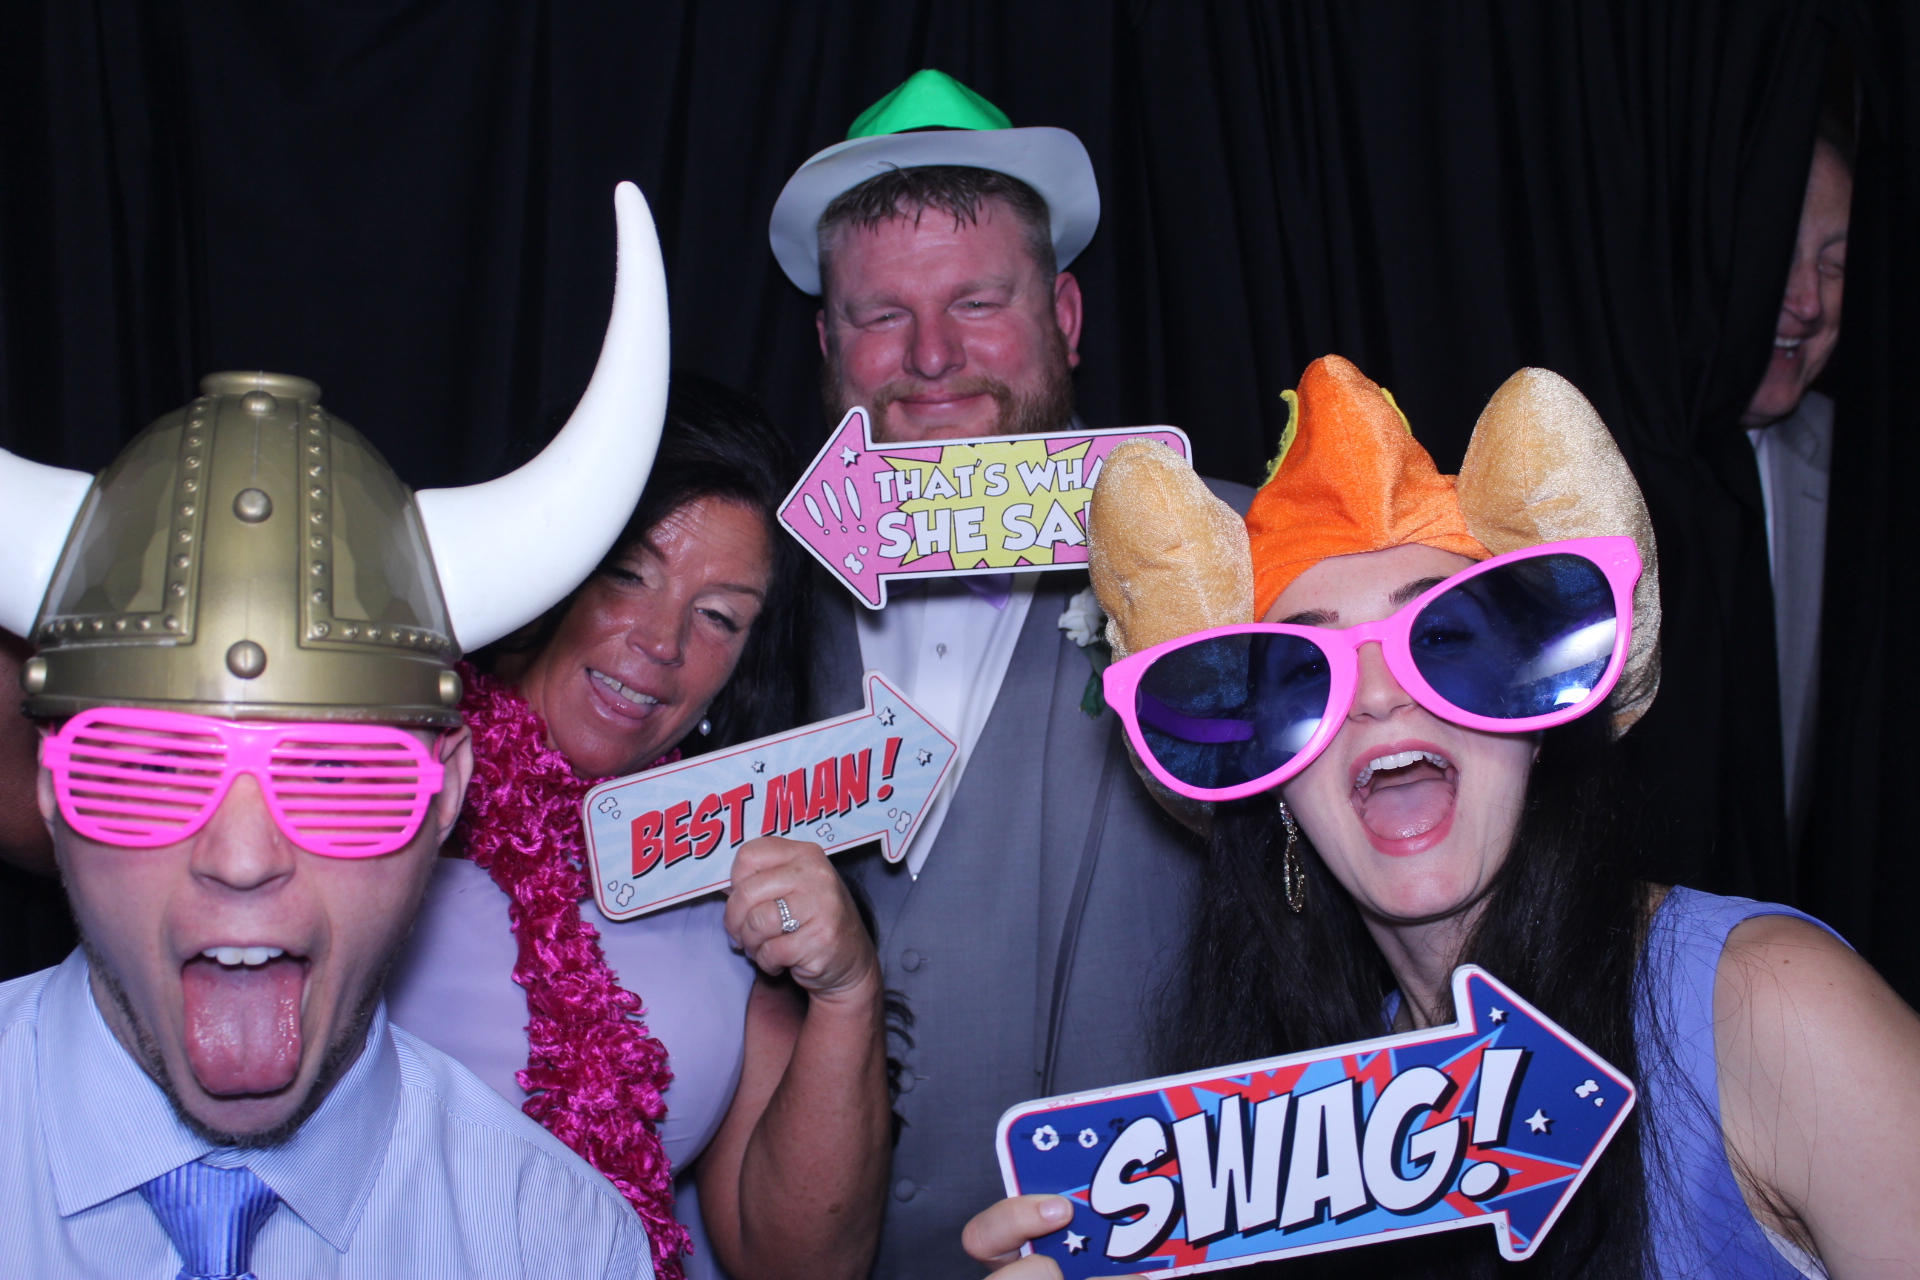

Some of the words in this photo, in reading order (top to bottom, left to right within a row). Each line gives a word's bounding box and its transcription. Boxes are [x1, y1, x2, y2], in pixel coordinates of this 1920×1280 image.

[873, 458, 1010, 504] THAT'S
[1015, 454, 1105, 497] WHA
[875, 505, 989, 559] SHE
[1001, 497, 1092, 552] SA
[630, 781, 754, 879] BEST
[1087, 1047, 1530, 1263] SWAG!
